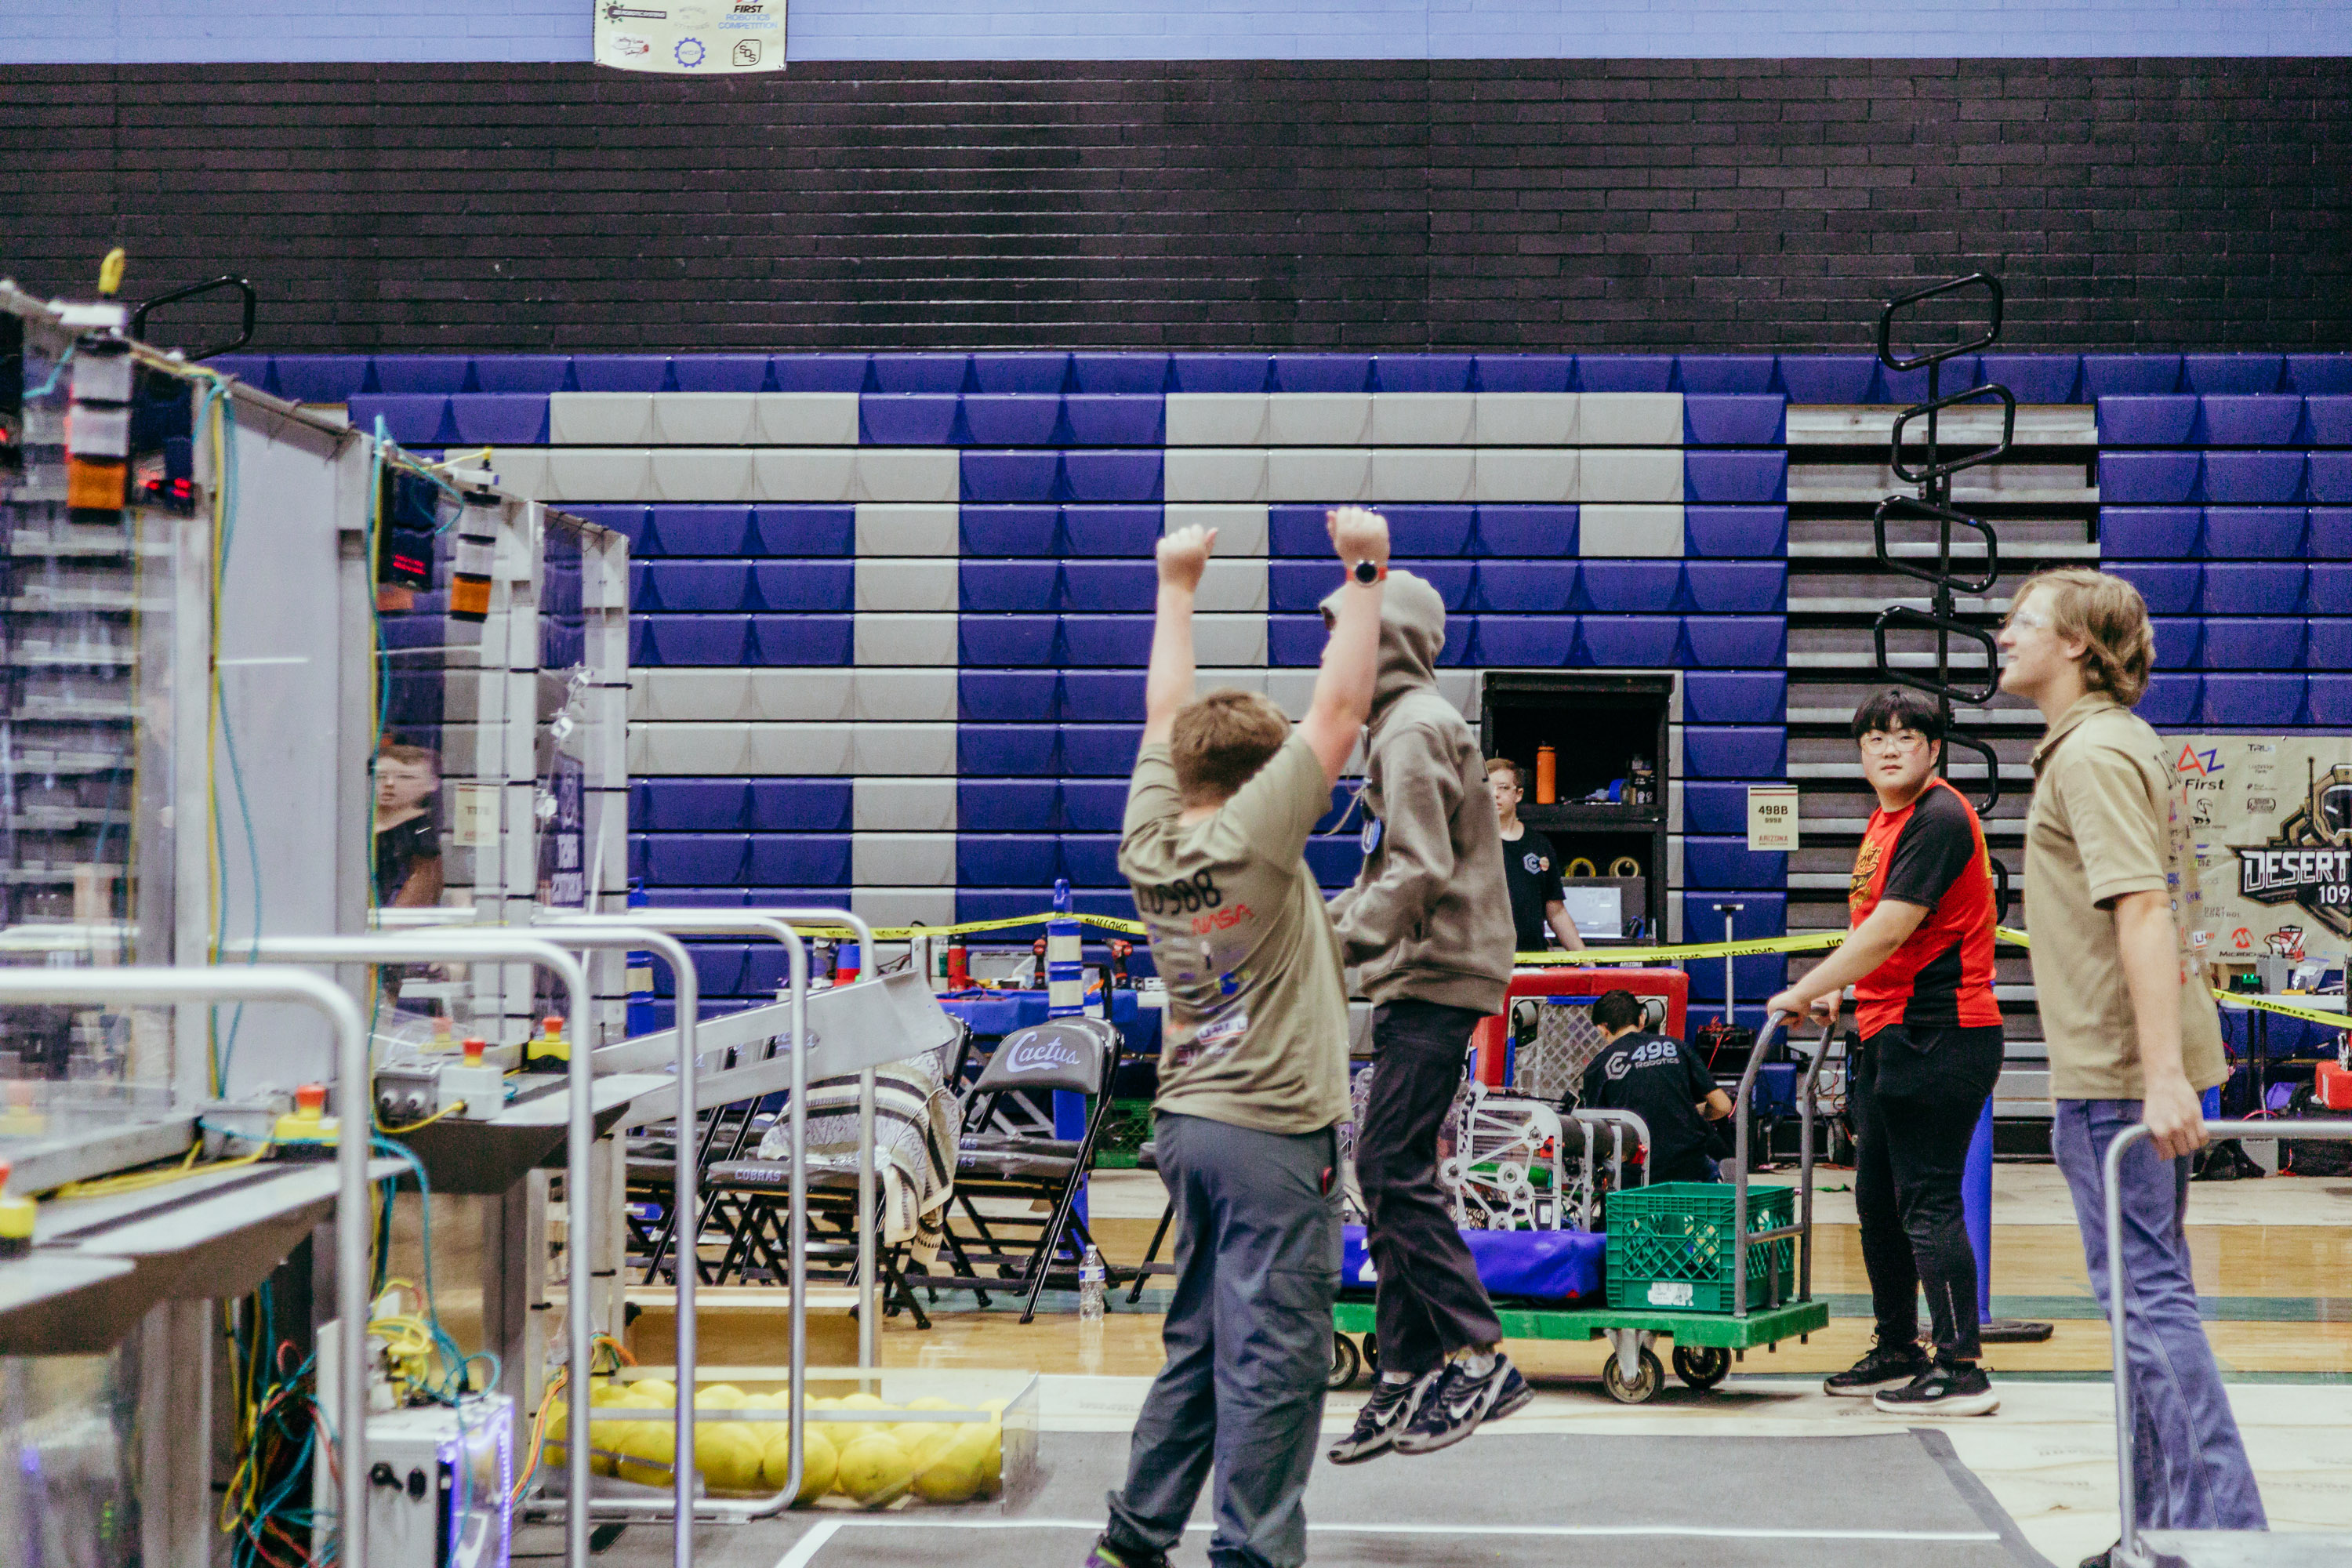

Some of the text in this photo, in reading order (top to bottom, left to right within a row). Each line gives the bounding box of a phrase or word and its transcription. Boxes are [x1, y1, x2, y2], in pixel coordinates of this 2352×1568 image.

[733, 5, 764, 13] FIRST
[2177, 744, 2225, 776] AZ
[2185, 779, 2224, 790] First
[2241, 851, 2351, 893] DESERT
[2318, 884, 2352, 904] 109
[1192, 904, 1254, 936] NASA
[1006, 1031, 1081, 1073] Cactus
[1632, 1041, 1677, 1062] 498
[735, 1168, 782, 1182] COBRAS
